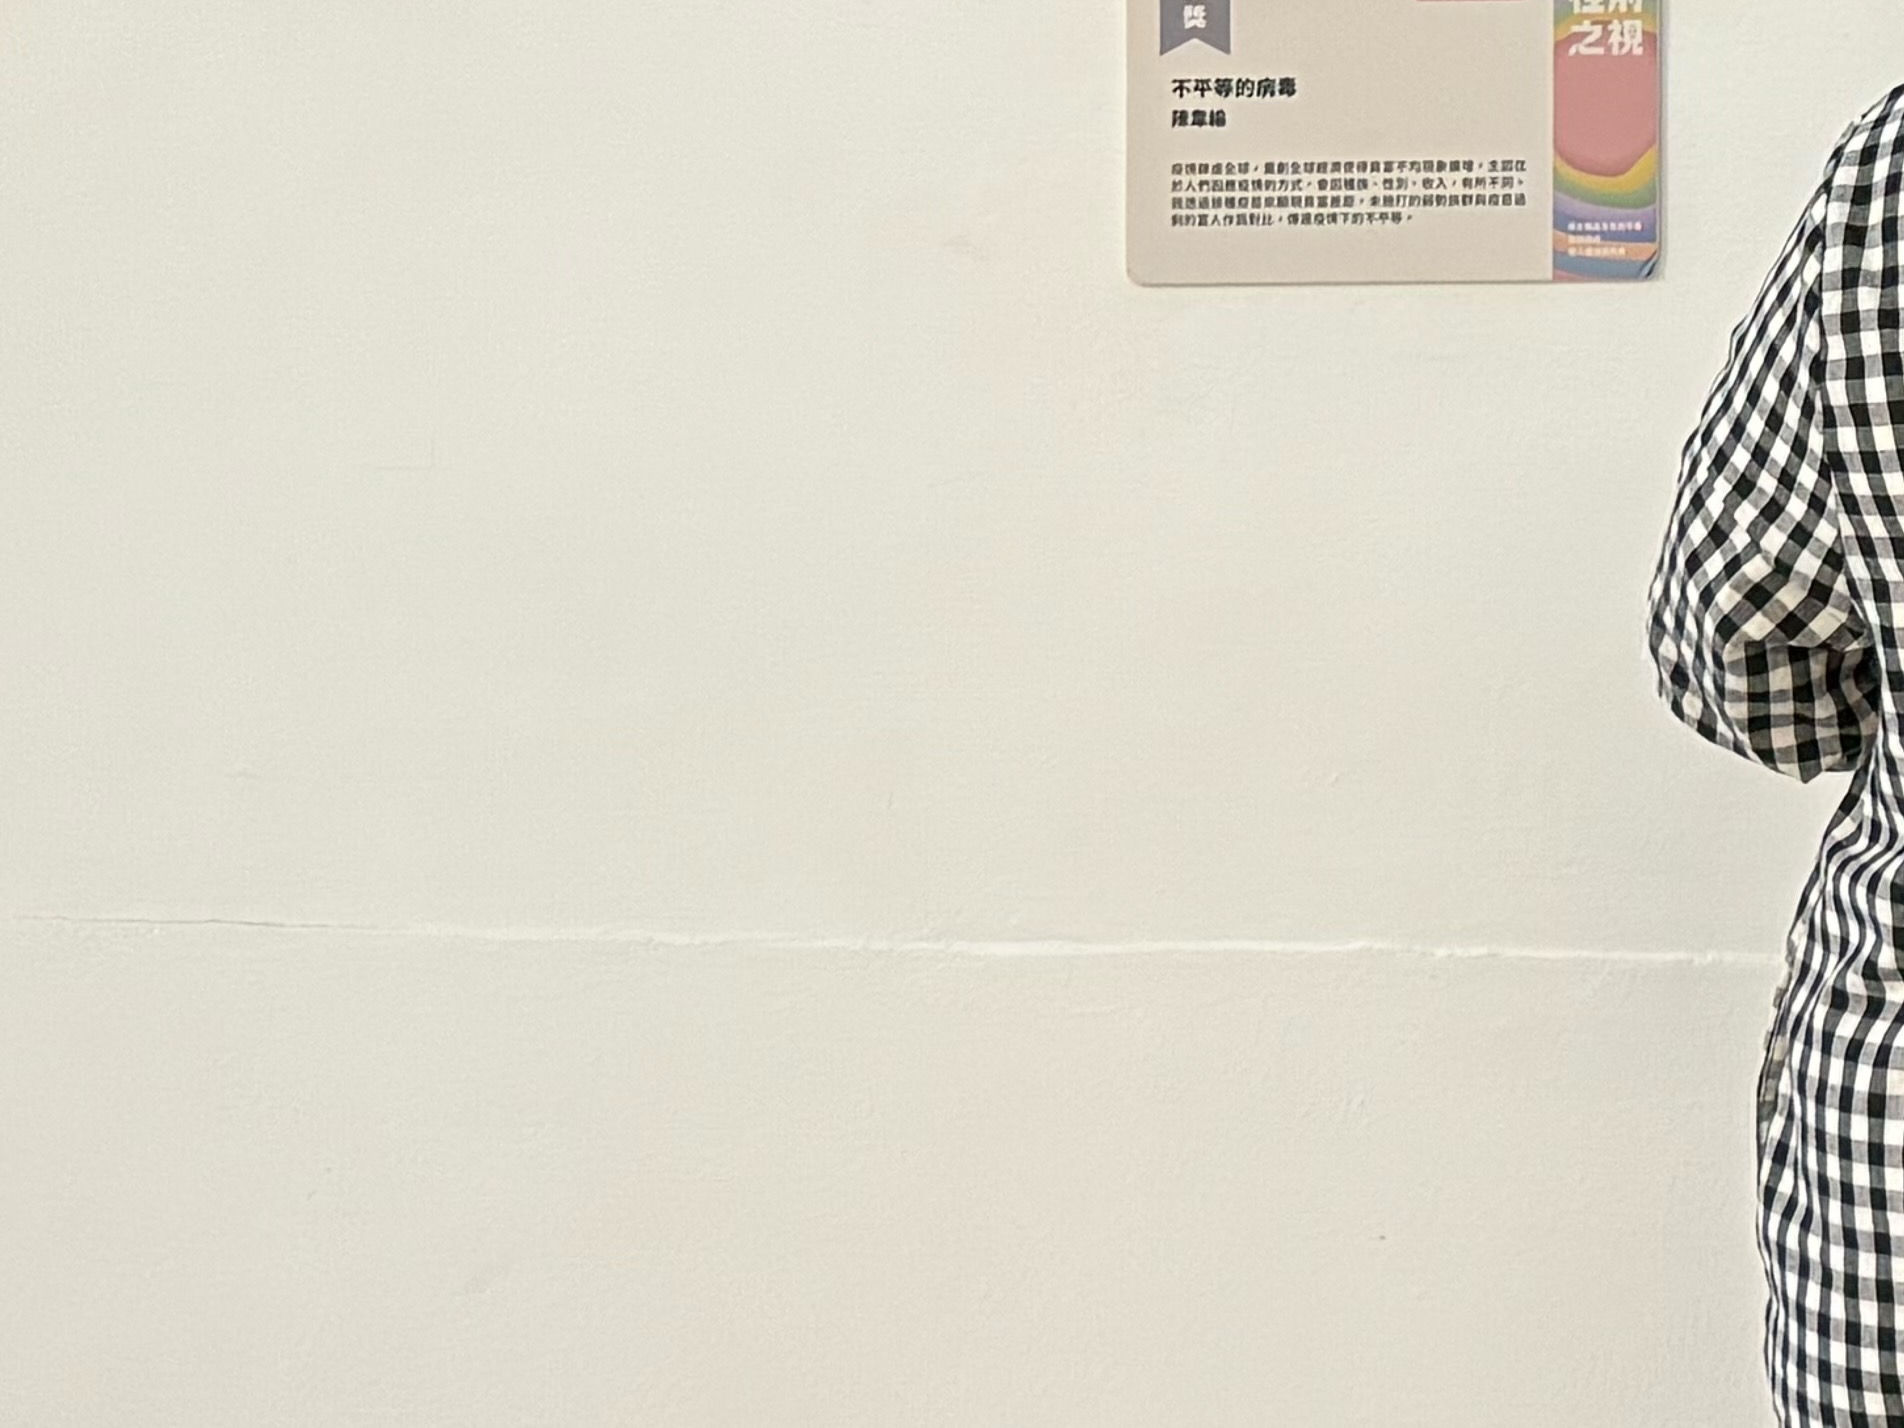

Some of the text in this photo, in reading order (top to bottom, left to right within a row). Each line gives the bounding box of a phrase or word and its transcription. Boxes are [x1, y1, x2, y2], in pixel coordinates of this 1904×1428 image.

[1567, 20, 1644, 57] 之視
[1171, 77, 1297, 99] 不平等的病毒
